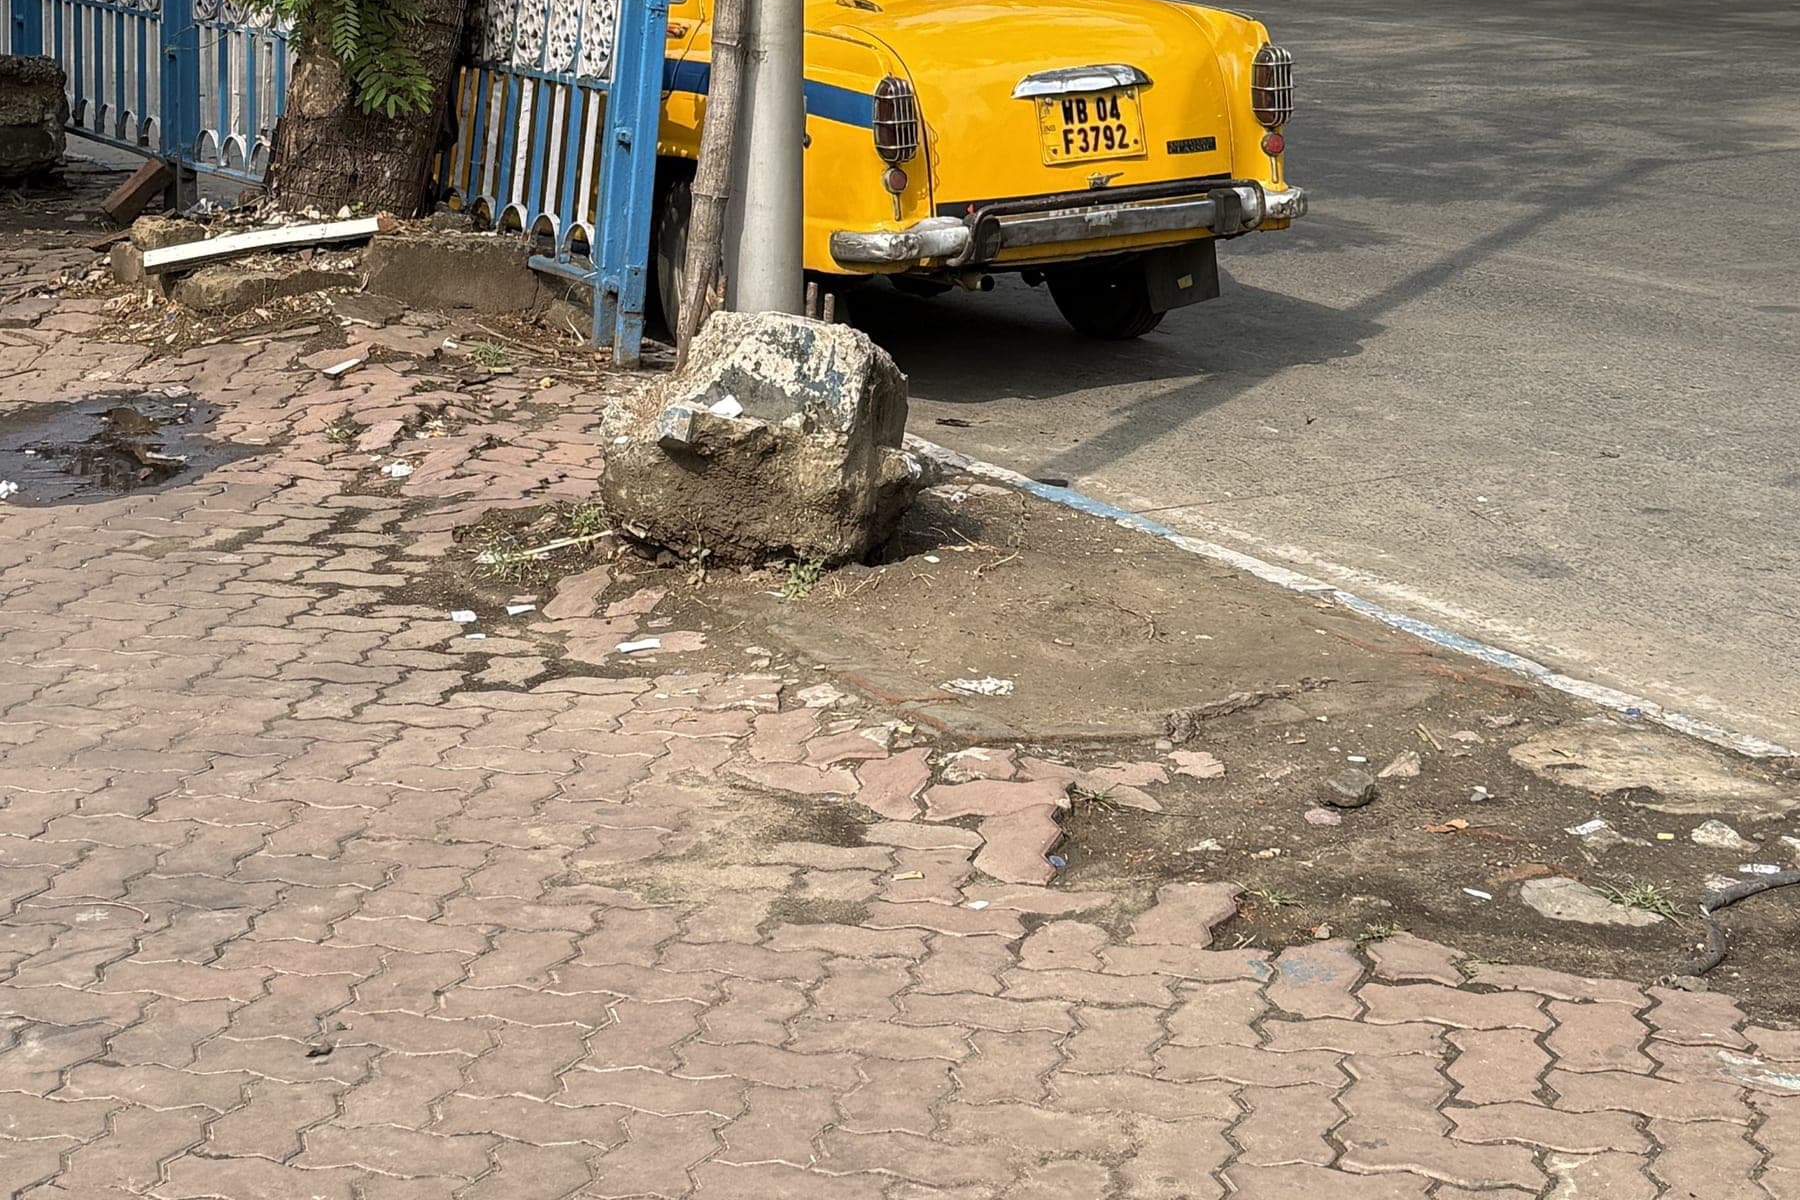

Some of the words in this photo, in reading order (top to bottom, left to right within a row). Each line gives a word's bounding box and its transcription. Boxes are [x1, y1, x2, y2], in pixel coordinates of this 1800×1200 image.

[1061, 97, 1088, 125] WB
[1096, 95, 1121, 122] 04
[1062, 123, 1130, 155] F3792
